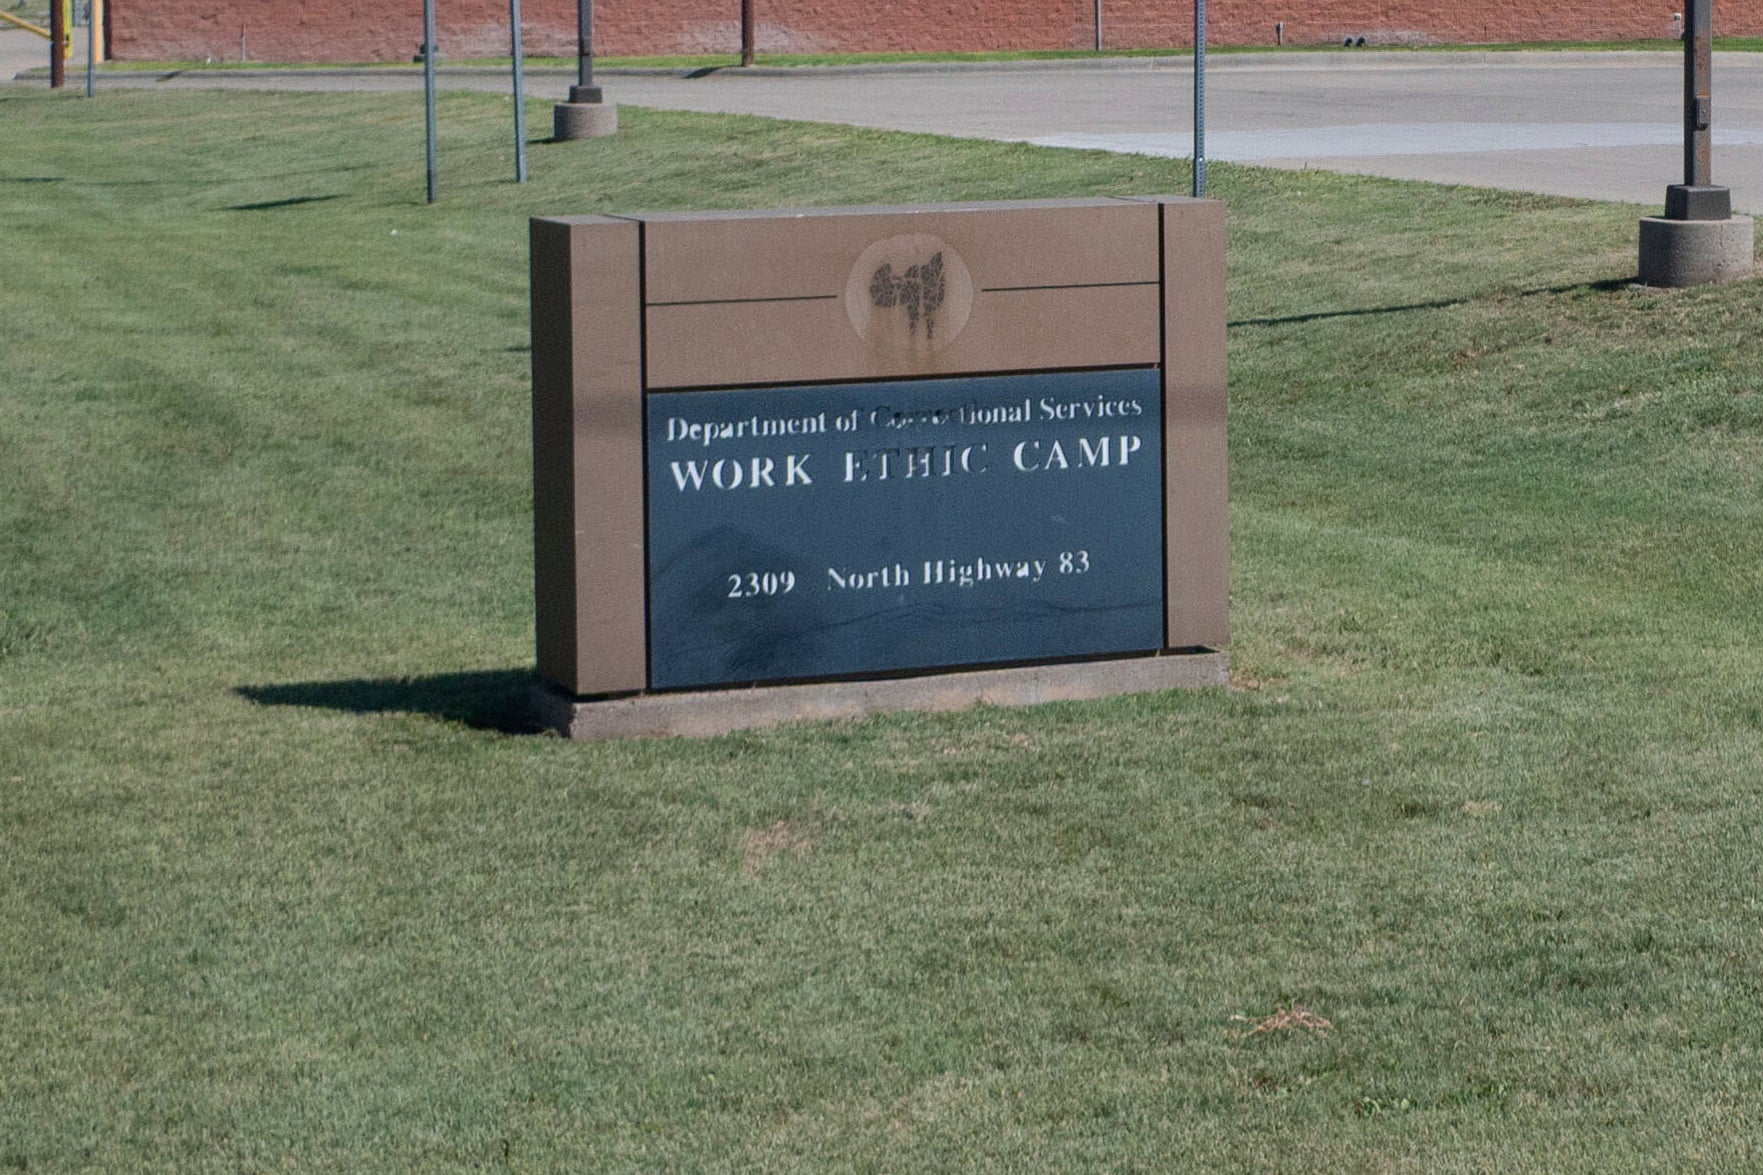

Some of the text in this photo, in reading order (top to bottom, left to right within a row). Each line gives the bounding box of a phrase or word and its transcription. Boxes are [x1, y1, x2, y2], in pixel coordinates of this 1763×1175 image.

[667, 394, 1143, 446] Department of Coetional Services
[670, 434, 1142, 493] WORK ETHIC CAMP
[727, 549, 1092, 599] 2309 North Highway 83
